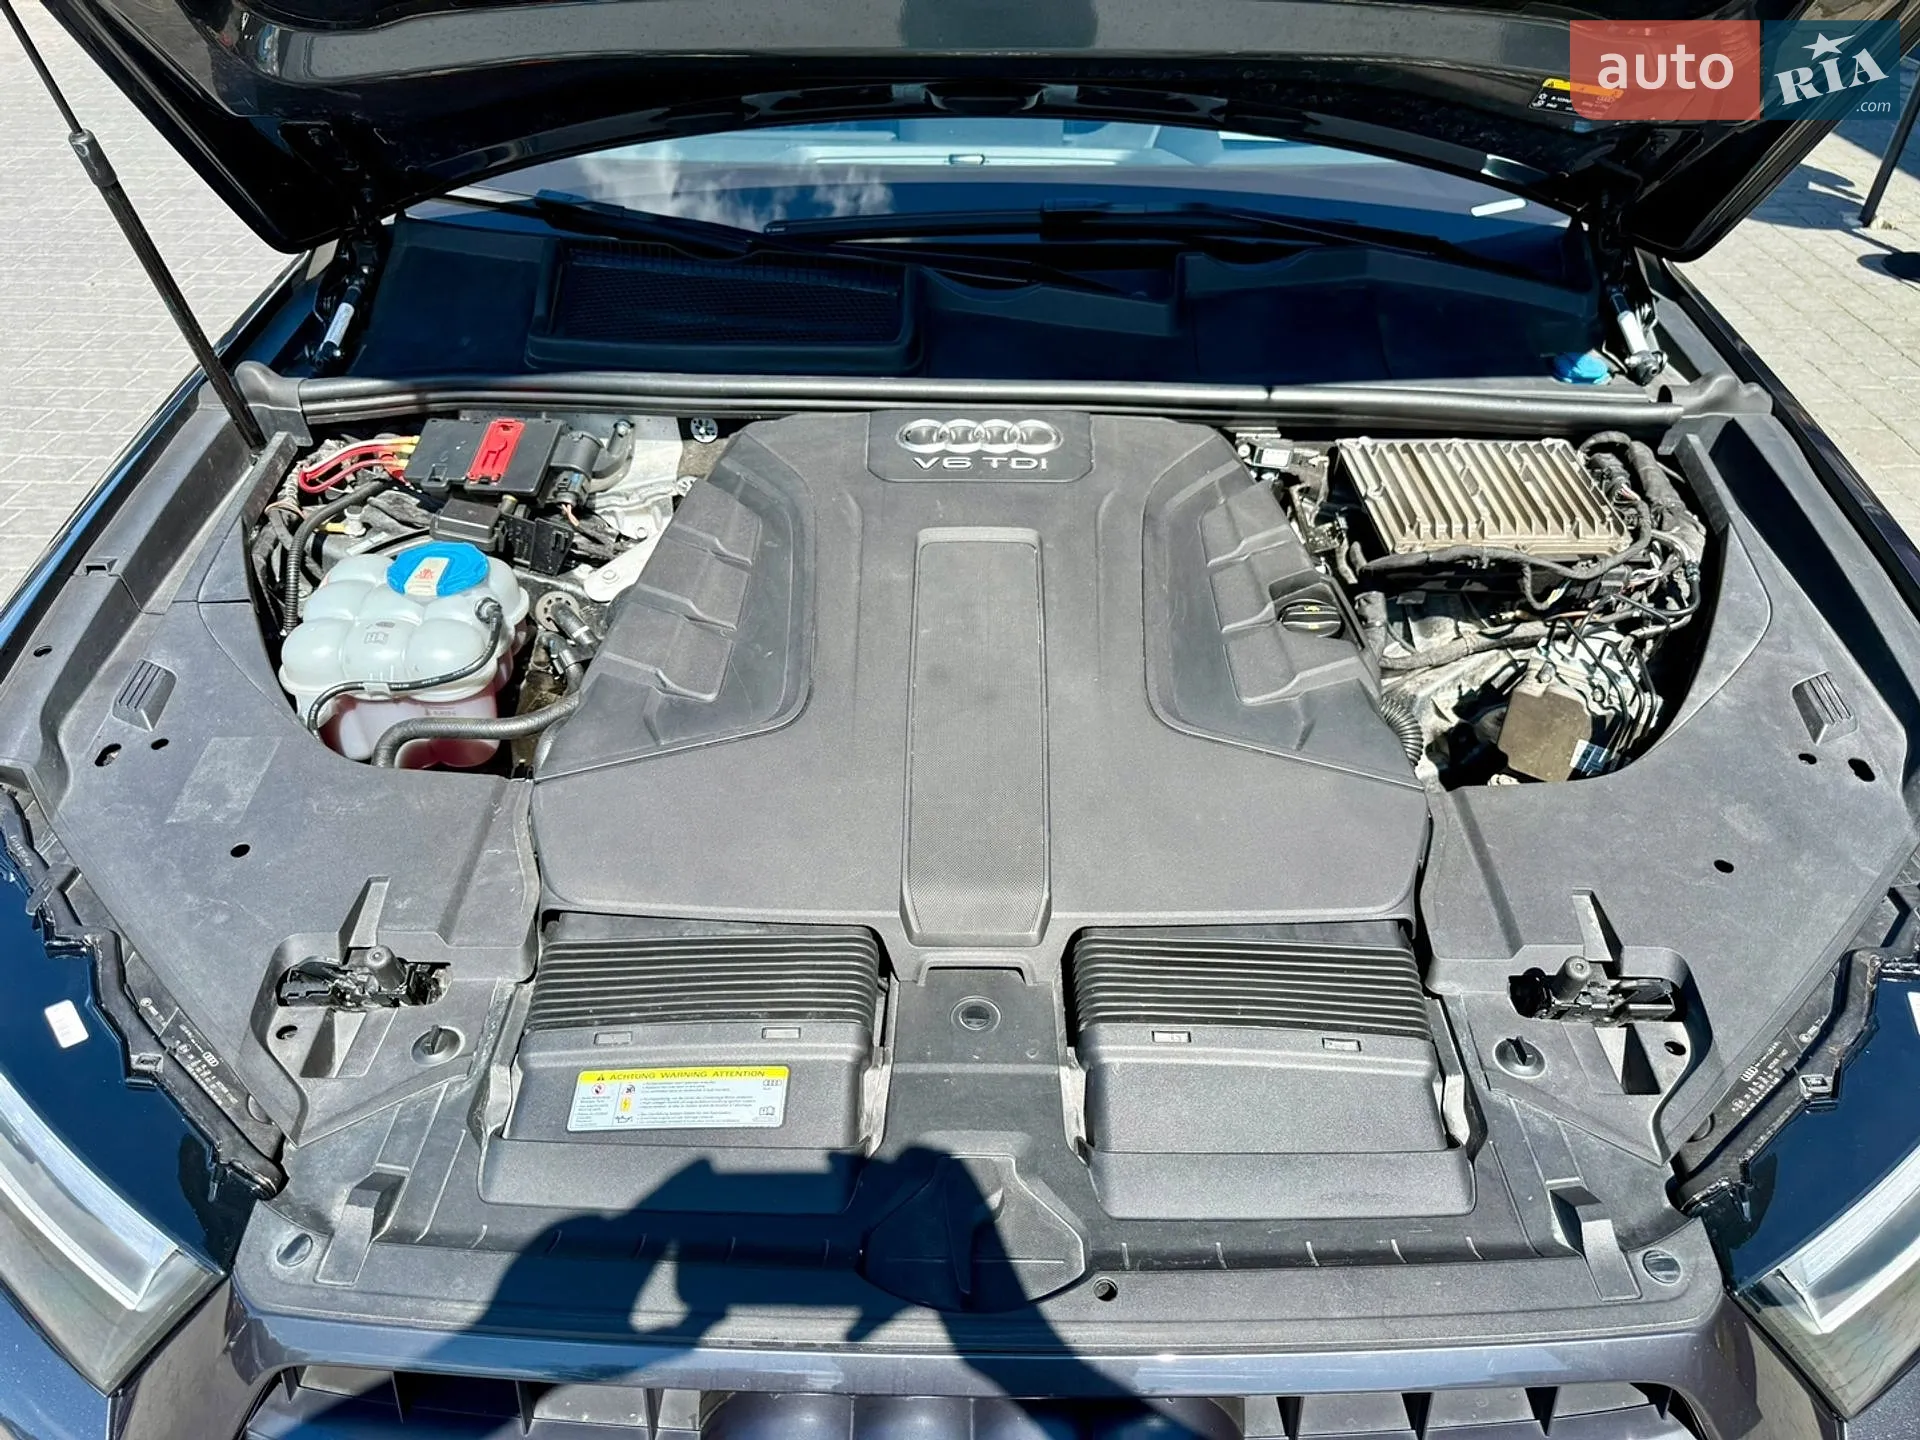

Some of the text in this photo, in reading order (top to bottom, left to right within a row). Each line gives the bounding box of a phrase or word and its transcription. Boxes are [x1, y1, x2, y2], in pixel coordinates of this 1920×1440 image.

[913, 457, 1047, 470] V6 TDI
[610, 1070, 765, 1080] ACHTUNG WARNING ATTENTION
